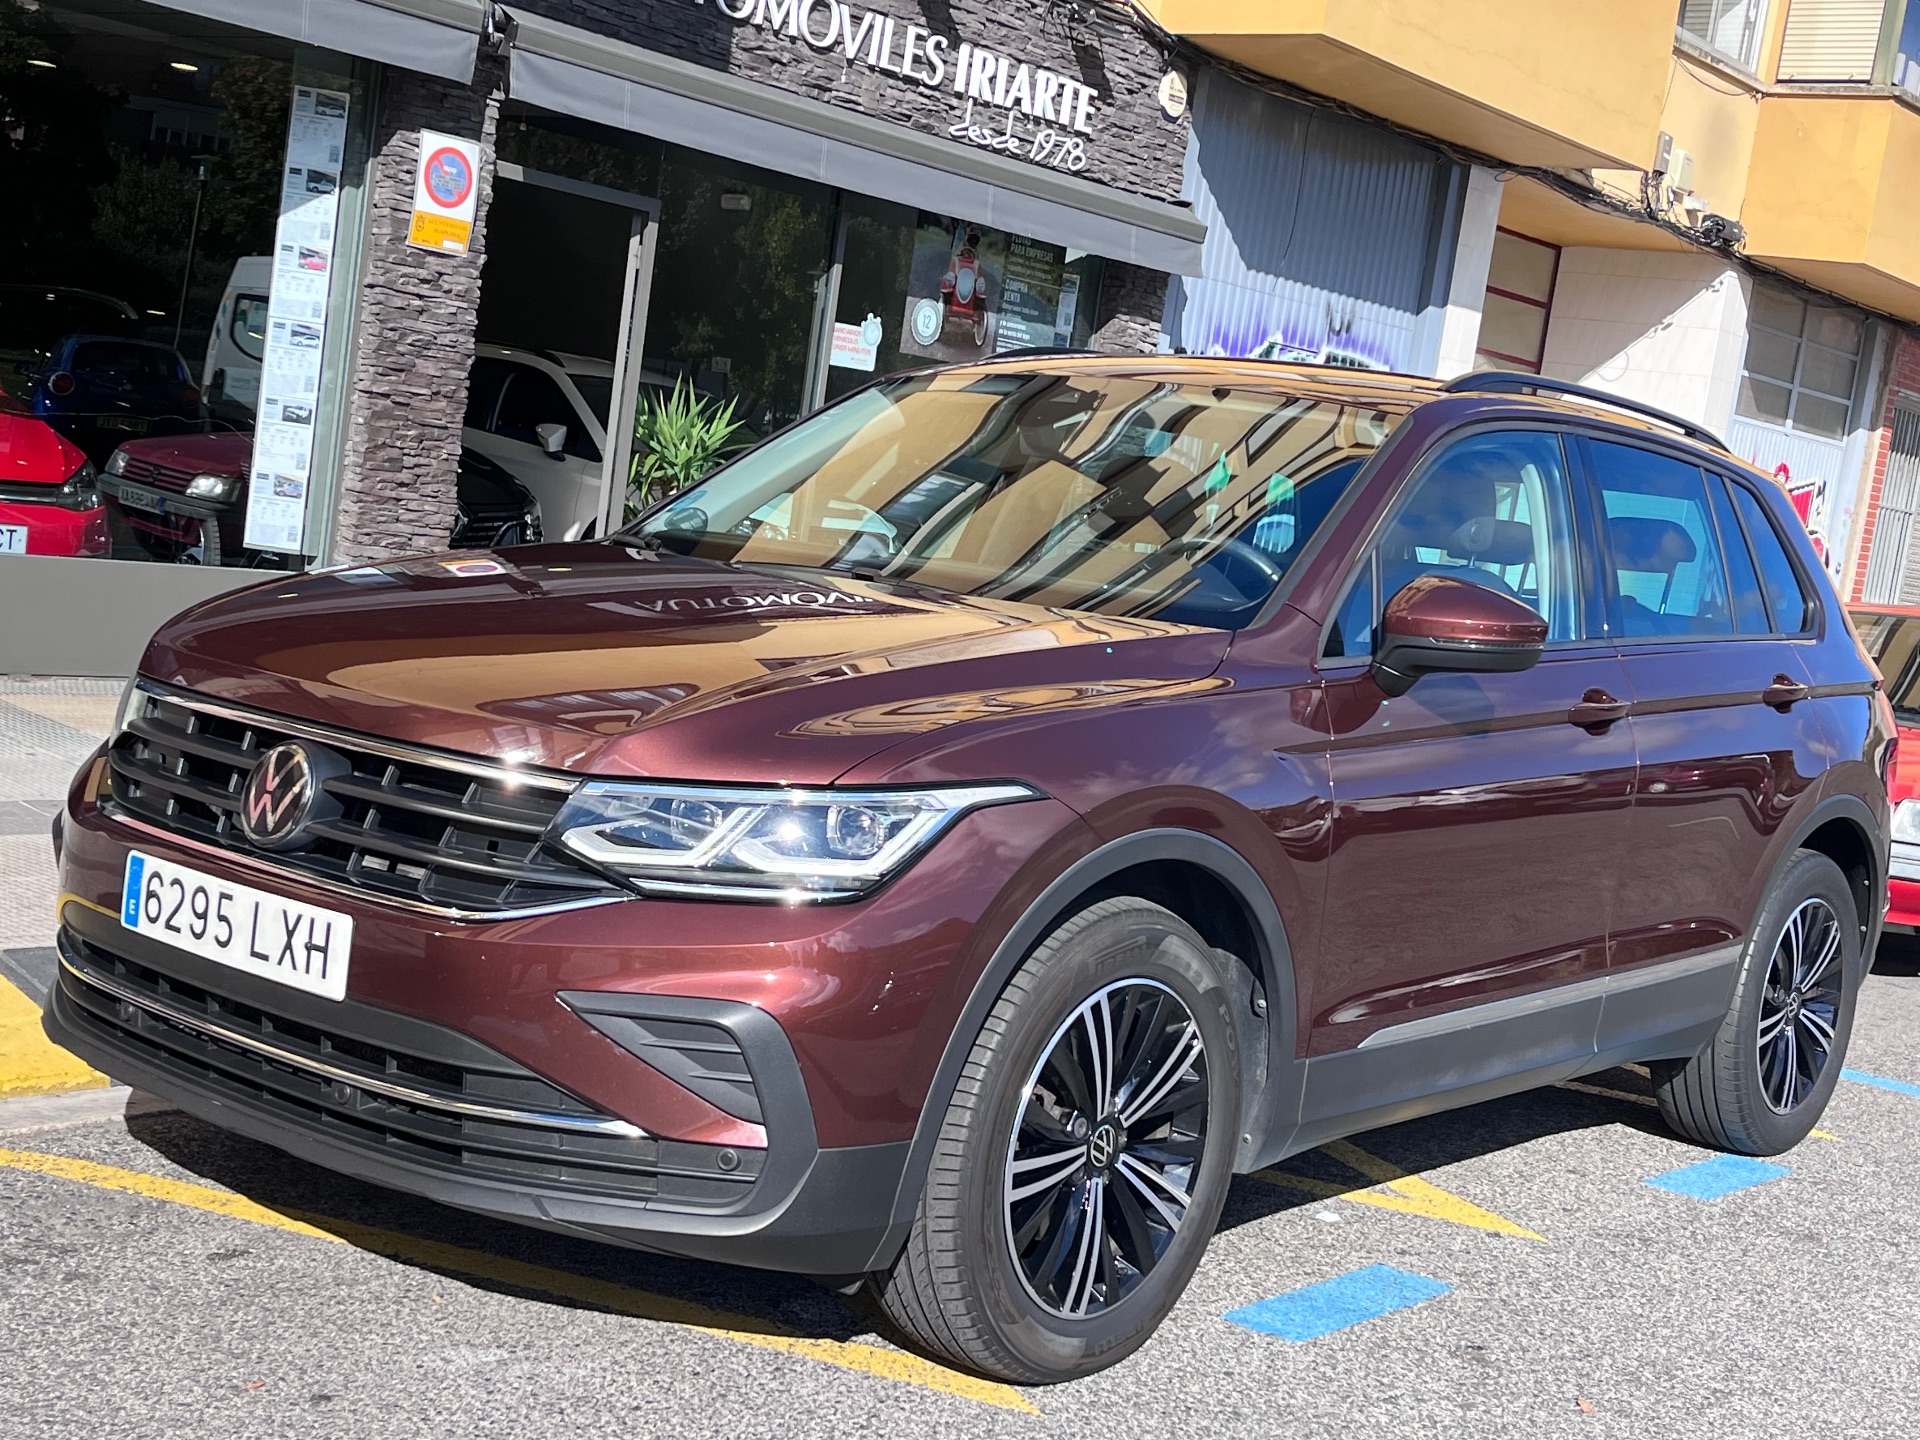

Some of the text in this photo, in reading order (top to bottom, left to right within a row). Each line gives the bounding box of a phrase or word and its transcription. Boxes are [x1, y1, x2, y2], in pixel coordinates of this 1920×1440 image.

[953, 42, 1098, 135] IRIARTE
[948, 97, 1086, 171] desde 1978
[922, 314, 932, 329] 12
[129, 899, 137, 915] E
[144, 870, 332, 980] 6295 LXH
